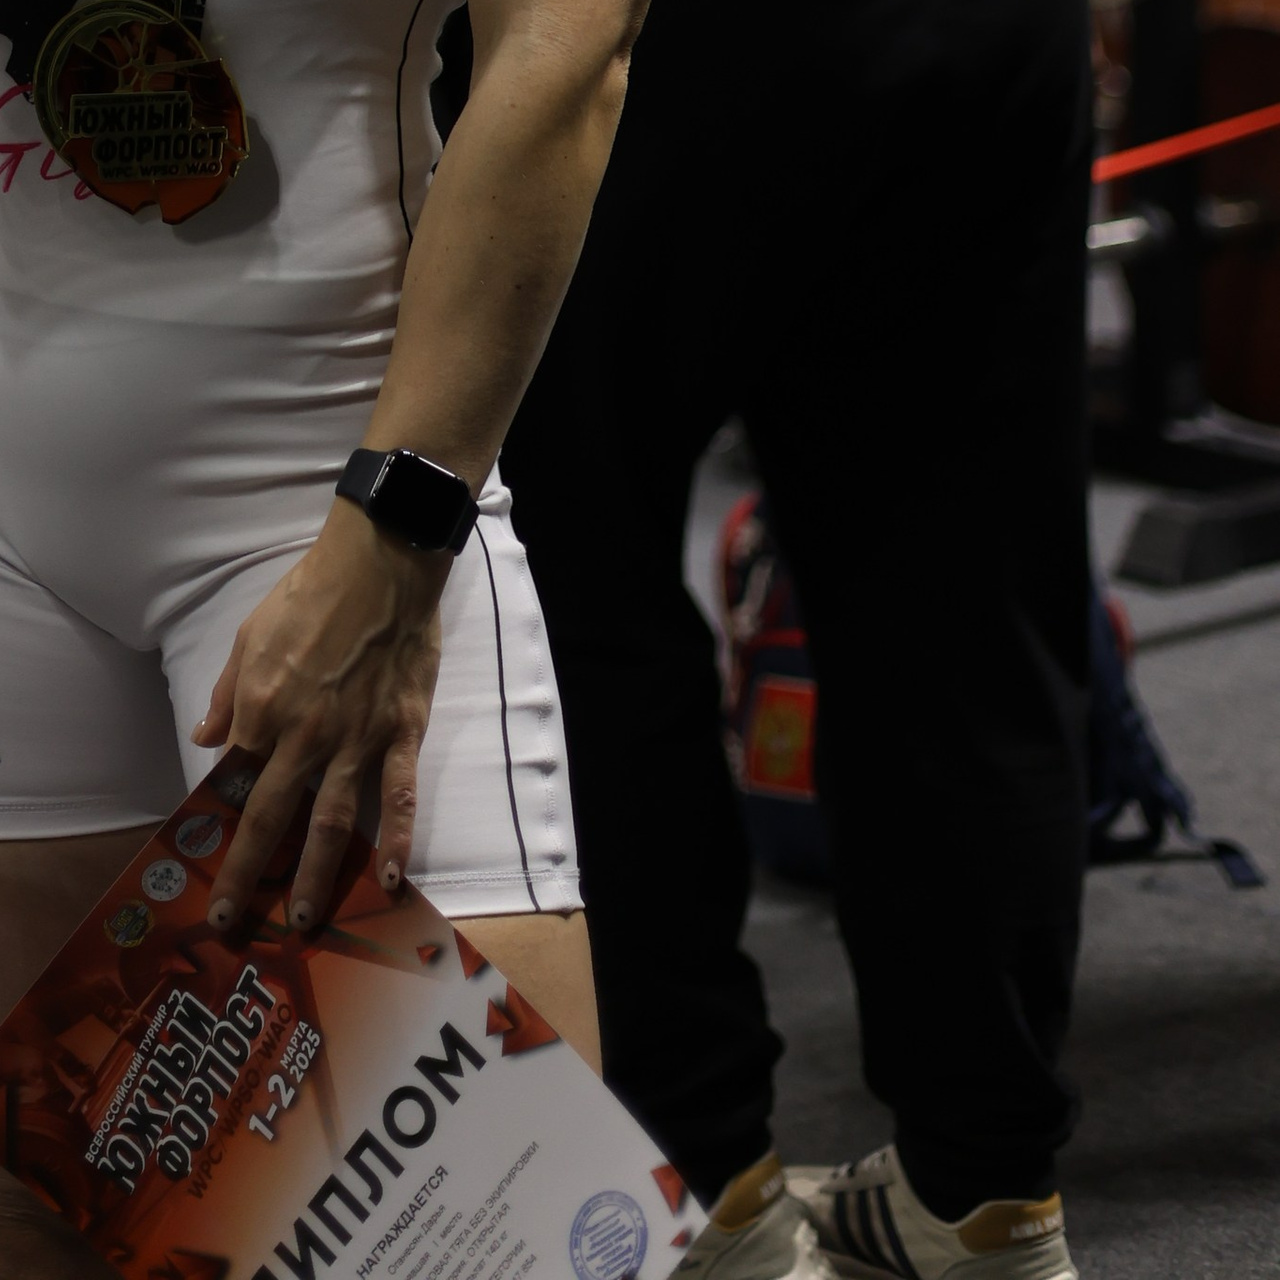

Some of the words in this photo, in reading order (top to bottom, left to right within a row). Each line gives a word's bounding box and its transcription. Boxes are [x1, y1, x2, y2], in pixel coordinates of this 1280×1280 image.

[73, 95, 190, 134] ЮЖНЫЙ
[96, 131, 226, 164] ФОРПОСТ
[156, 964, 276, 1182] ФОРПОСТ
[279, 1020, 310, 1070] МАРТА
[289, 1029, 320, 1084] 2025
[85, 1051, 146, 1164] ВСЕРОССИЙСКИЙ
[139, 1004, 168, 1053] ТУРНИР
[97, 989, 218, 1195] ЮЖНЫЙ
[248, 1074, 296, 1142] 1-2
[251, 1021, 488, 1280] ИПЛОМ
[356, 1165, 449, 1280] НАГРАЖДАЕТСЯ
[469, 1207, 488, 1231] БЕЗ
